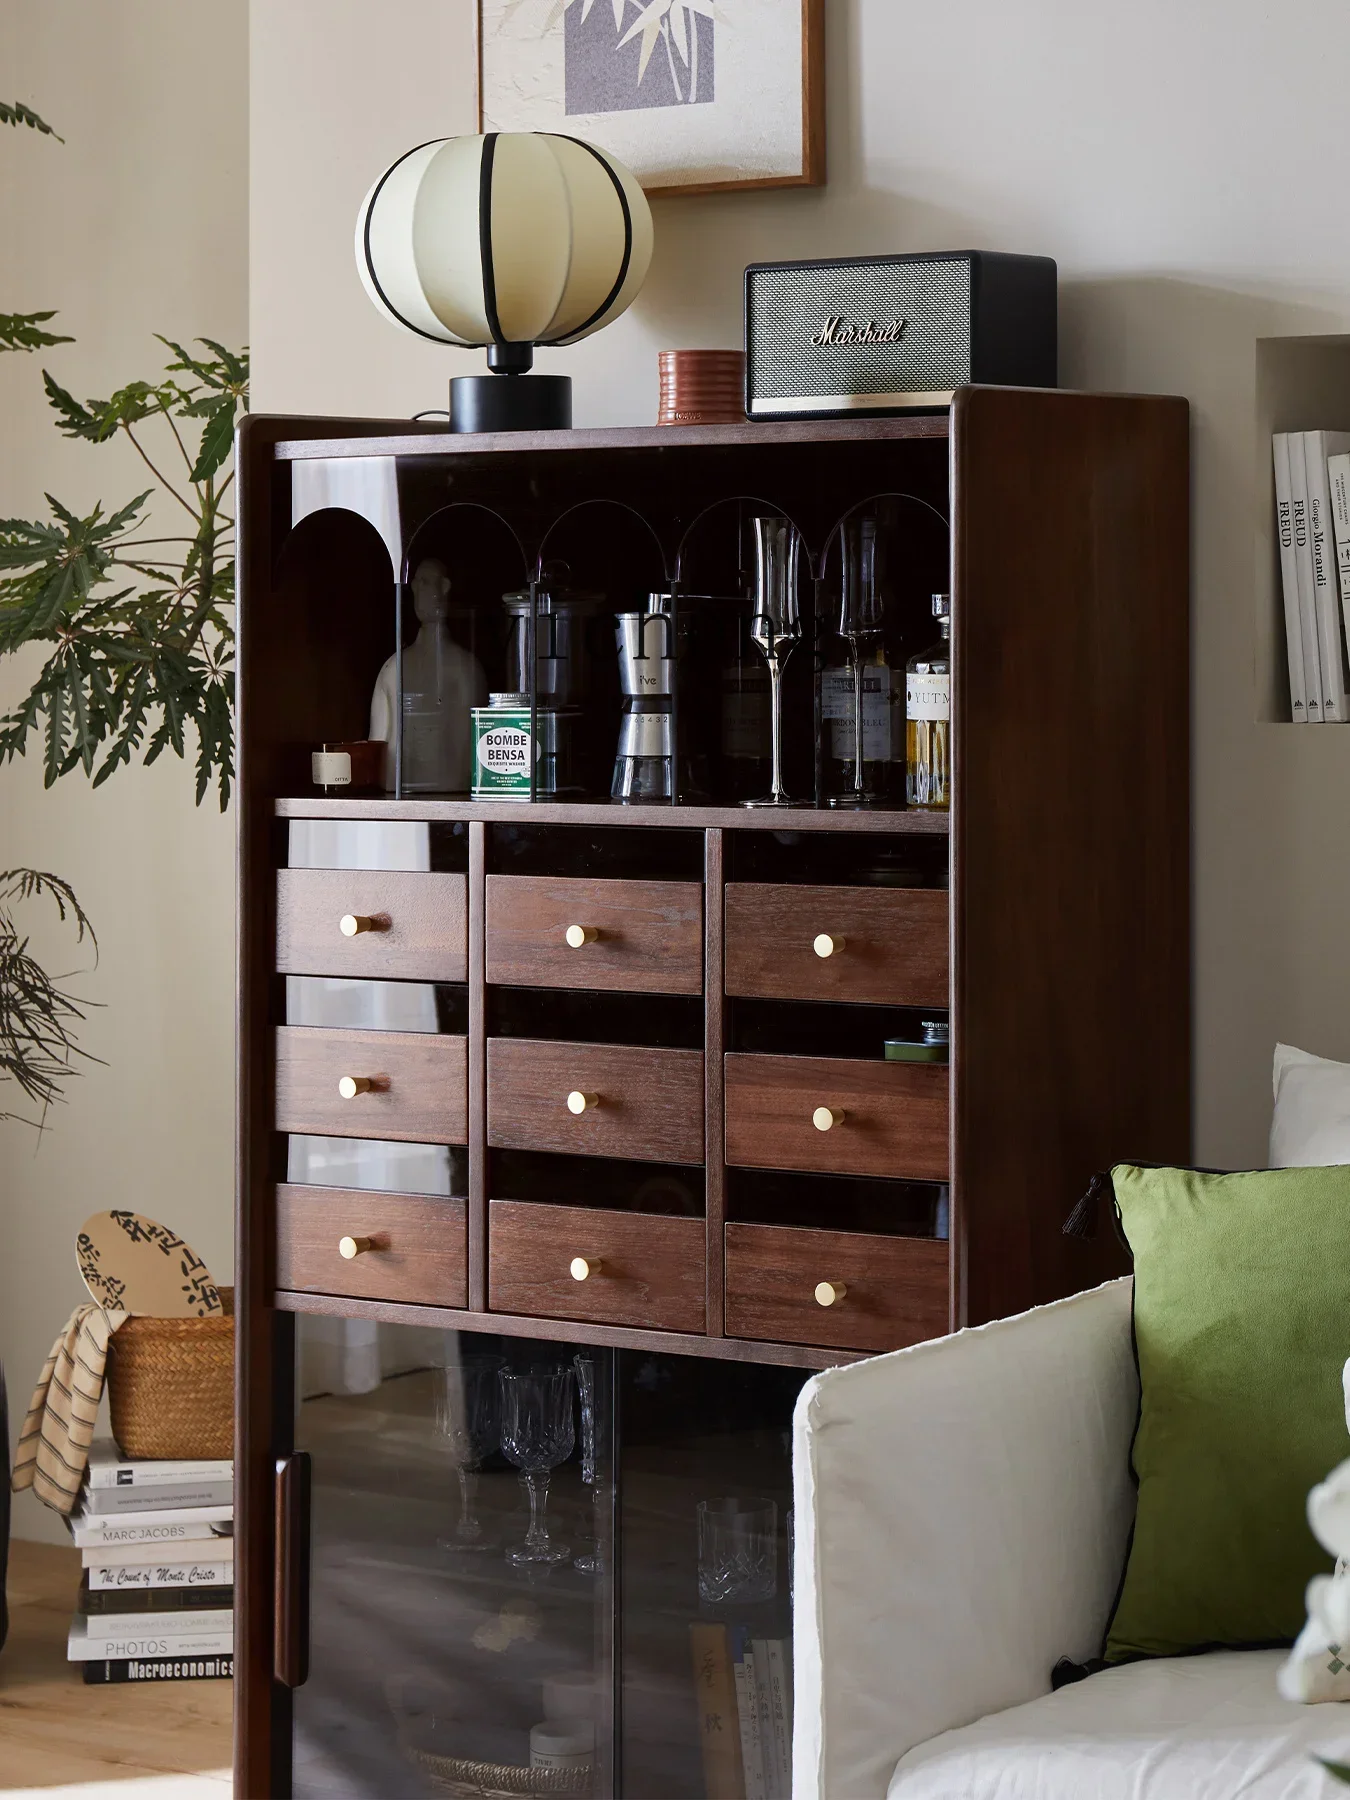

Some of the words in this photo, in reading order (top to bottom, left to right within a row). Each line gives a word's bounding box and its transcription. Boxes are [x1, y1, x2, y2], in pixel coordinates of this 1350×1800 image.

[810, 316, 903, 345] Marshall
[1294, 500, 1306, 547] FREUD
[1312, 498, 1321, 530] Giorgio
[1279, 501, 1291, 548] FREUD
[1313, 531, 1326, 587] Morandi
[640, 675, 657, 685] i've
[486, 735, 527, 746] BOMBE
[488, 749, 525, 760] BENSA
[103, 1531, 136, 1541] MARC
[139, 1526, 185, 1539] JACOBS
[100, 1569, 114, 1584] The
[117, 1568, 141, 1585] Count
[143, 1568, 151, 1586] of
[157, 1567, 185, 1582] Monte
[188, 1566, 215, 1583] Cristo
[106, 1640, 168, 1656] PHOTOS
[128, 1659, 233, 1678] Macroeconomics
